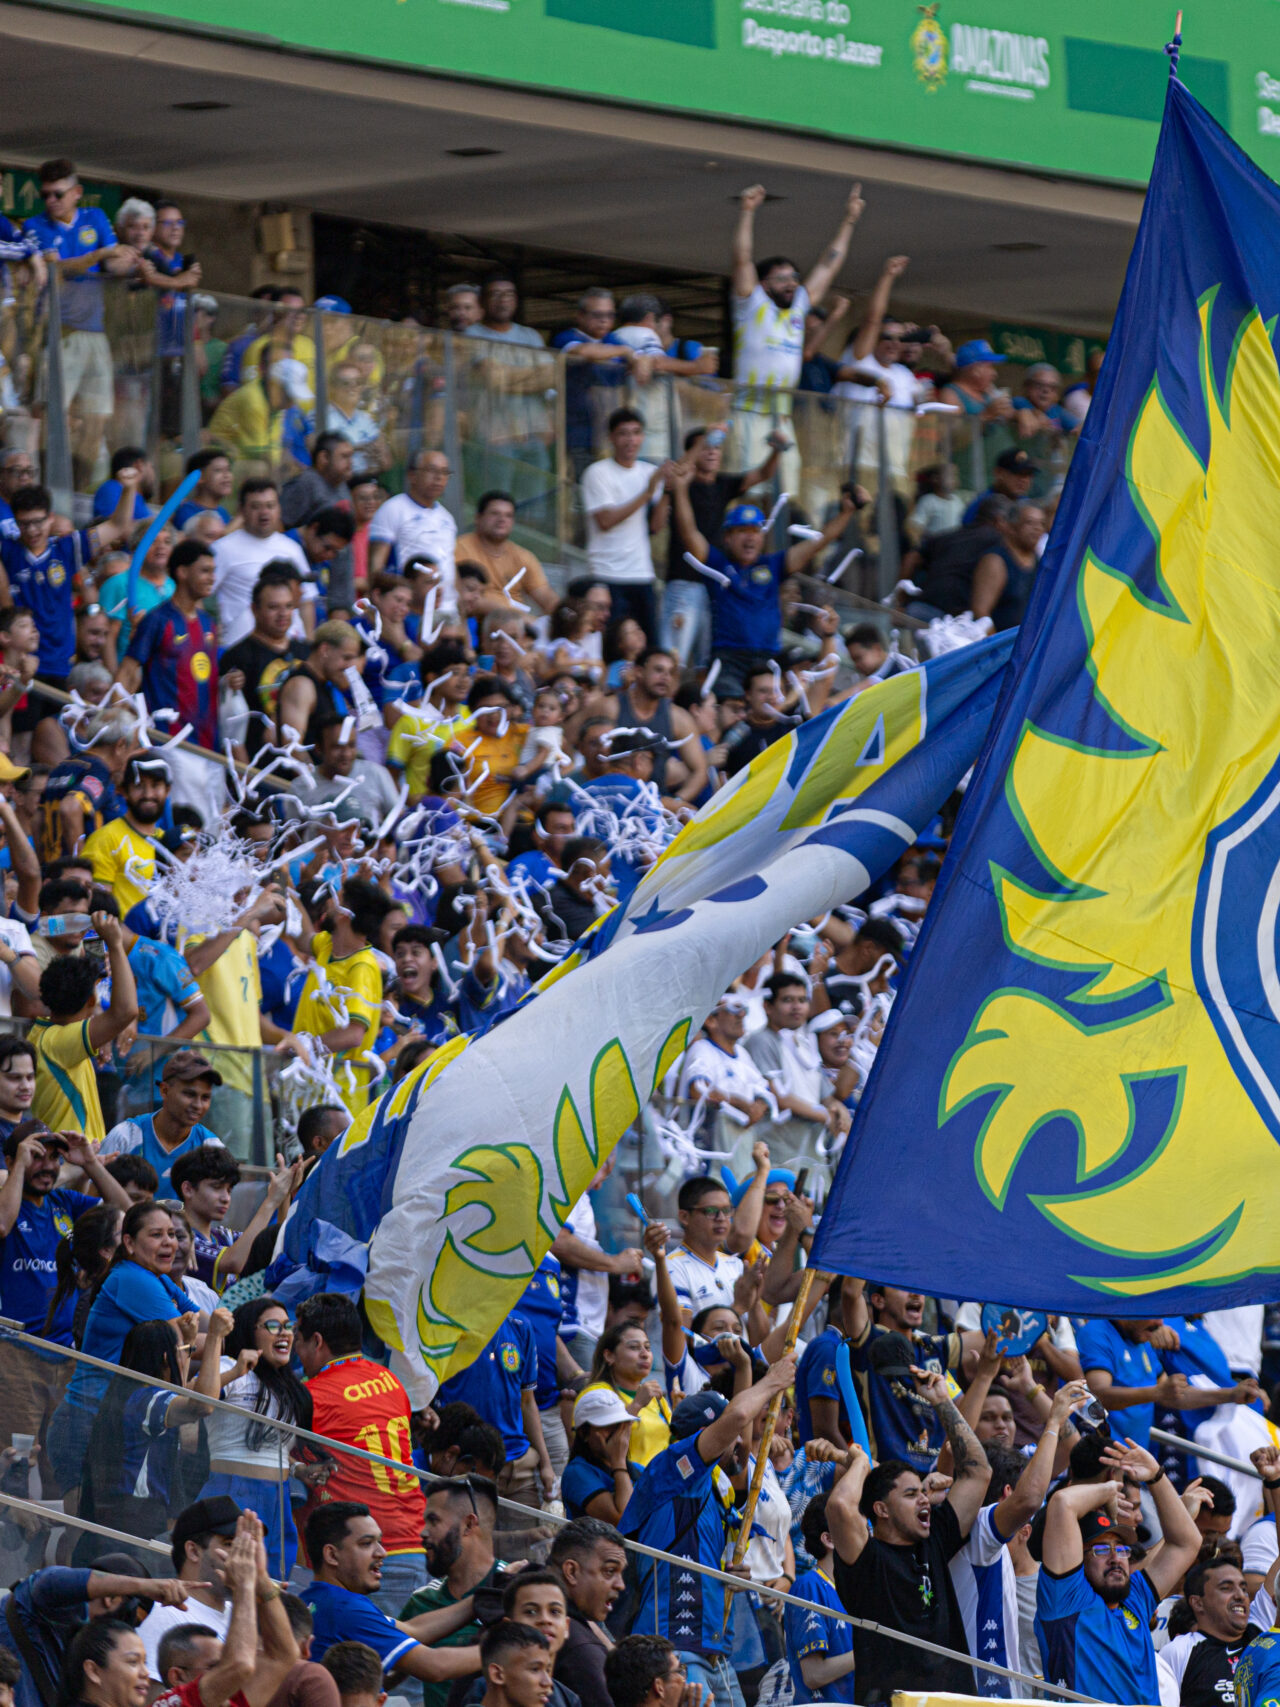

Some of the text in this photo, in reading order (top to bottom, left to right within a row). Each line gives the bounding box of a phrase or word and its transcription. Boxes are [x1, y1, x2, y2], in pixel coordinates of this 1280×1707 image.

[742, 17, 823, 57] Desporto
[950, 22, 1050, 88] AMAZONAS
[343, 1370, 400, 1402] amil
[353, 1415, 420, 1495] 10
